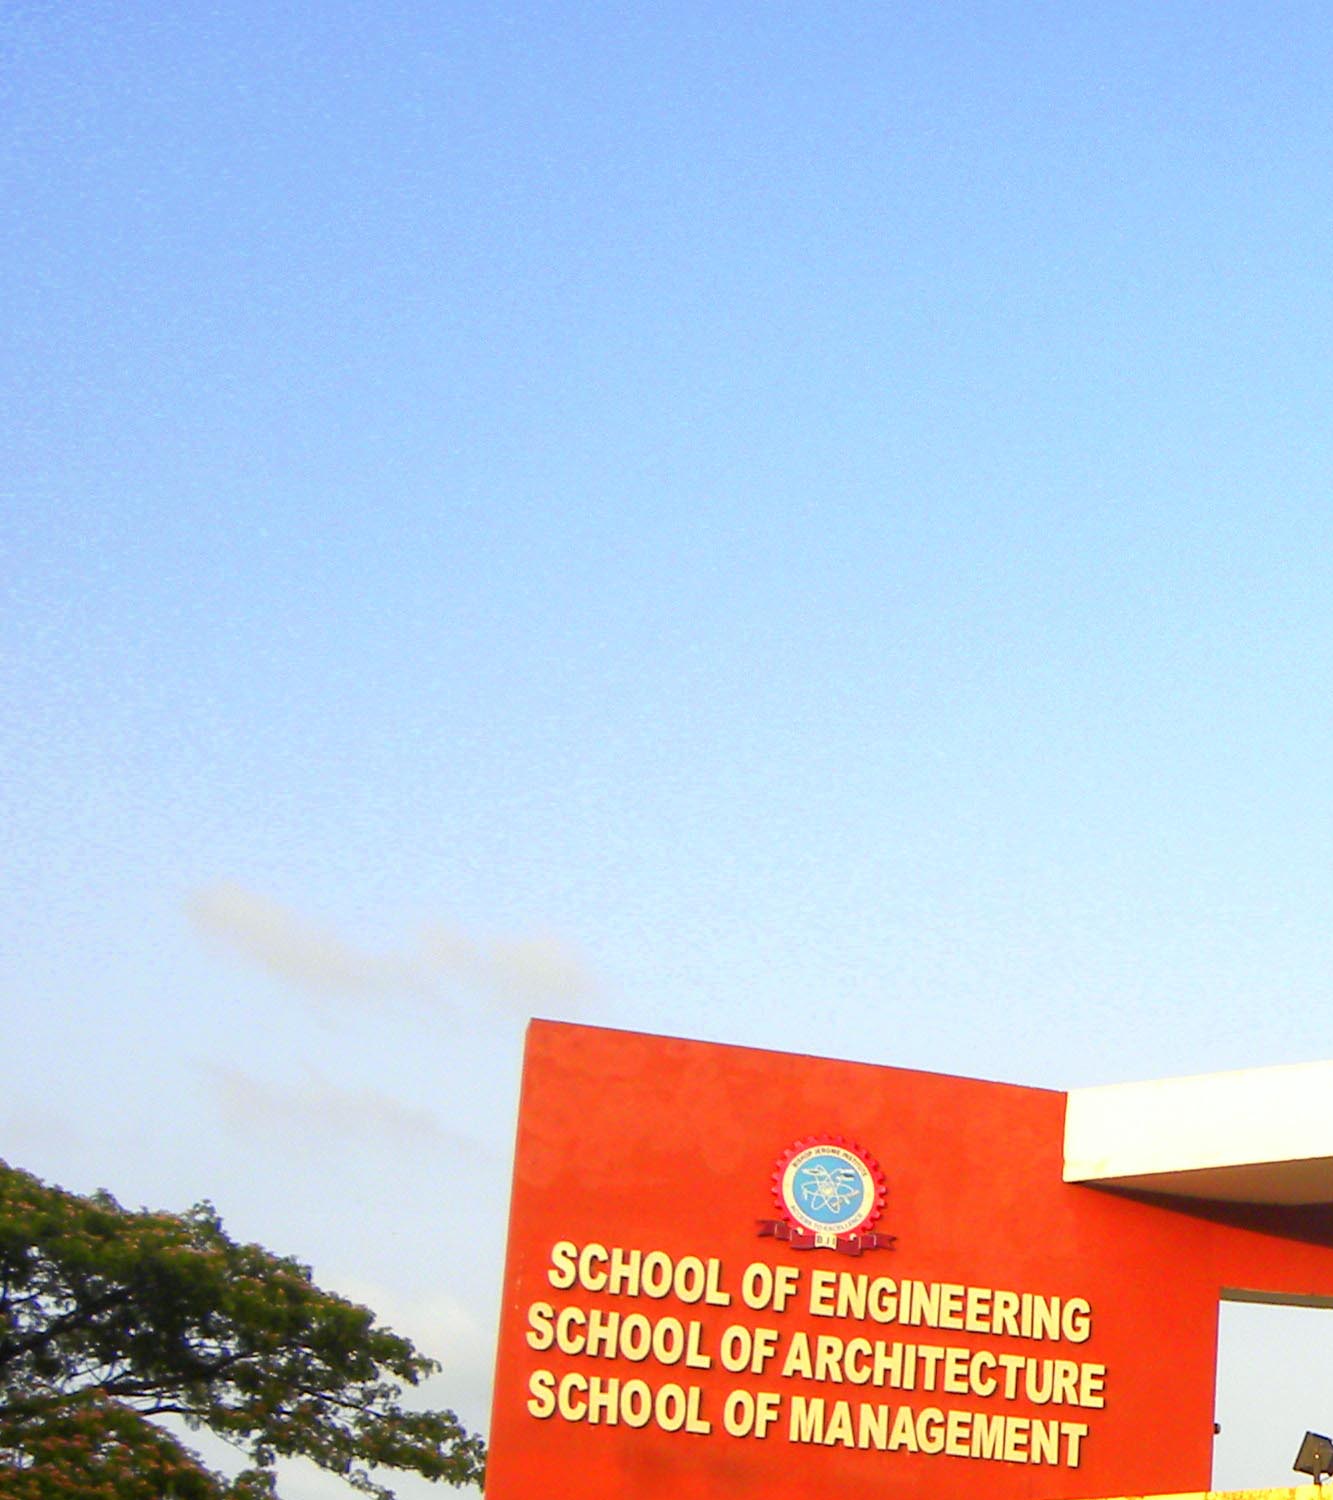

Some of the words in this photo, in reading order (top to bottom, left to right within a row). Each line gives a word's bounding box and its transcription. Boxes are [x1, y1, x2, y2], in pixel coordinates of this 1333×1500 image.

[547, 1239, 731, 1308] SCHOOL
[741, 1261, 800, 1313] OF
[808, 1269, 1092, 1344] ENGINEERING
[525, 1300, 712, 1370] SCHOOL
[718, 1323, 779, 1376] OF
[780, 1331, 1107, 1409] ARCHITECTURE
[526, 1368, 711, 1435] SCHOOL
[723, 1390, 781, 1439] OF
[788, 1396, 1089, 1468] MANAGEMENT
